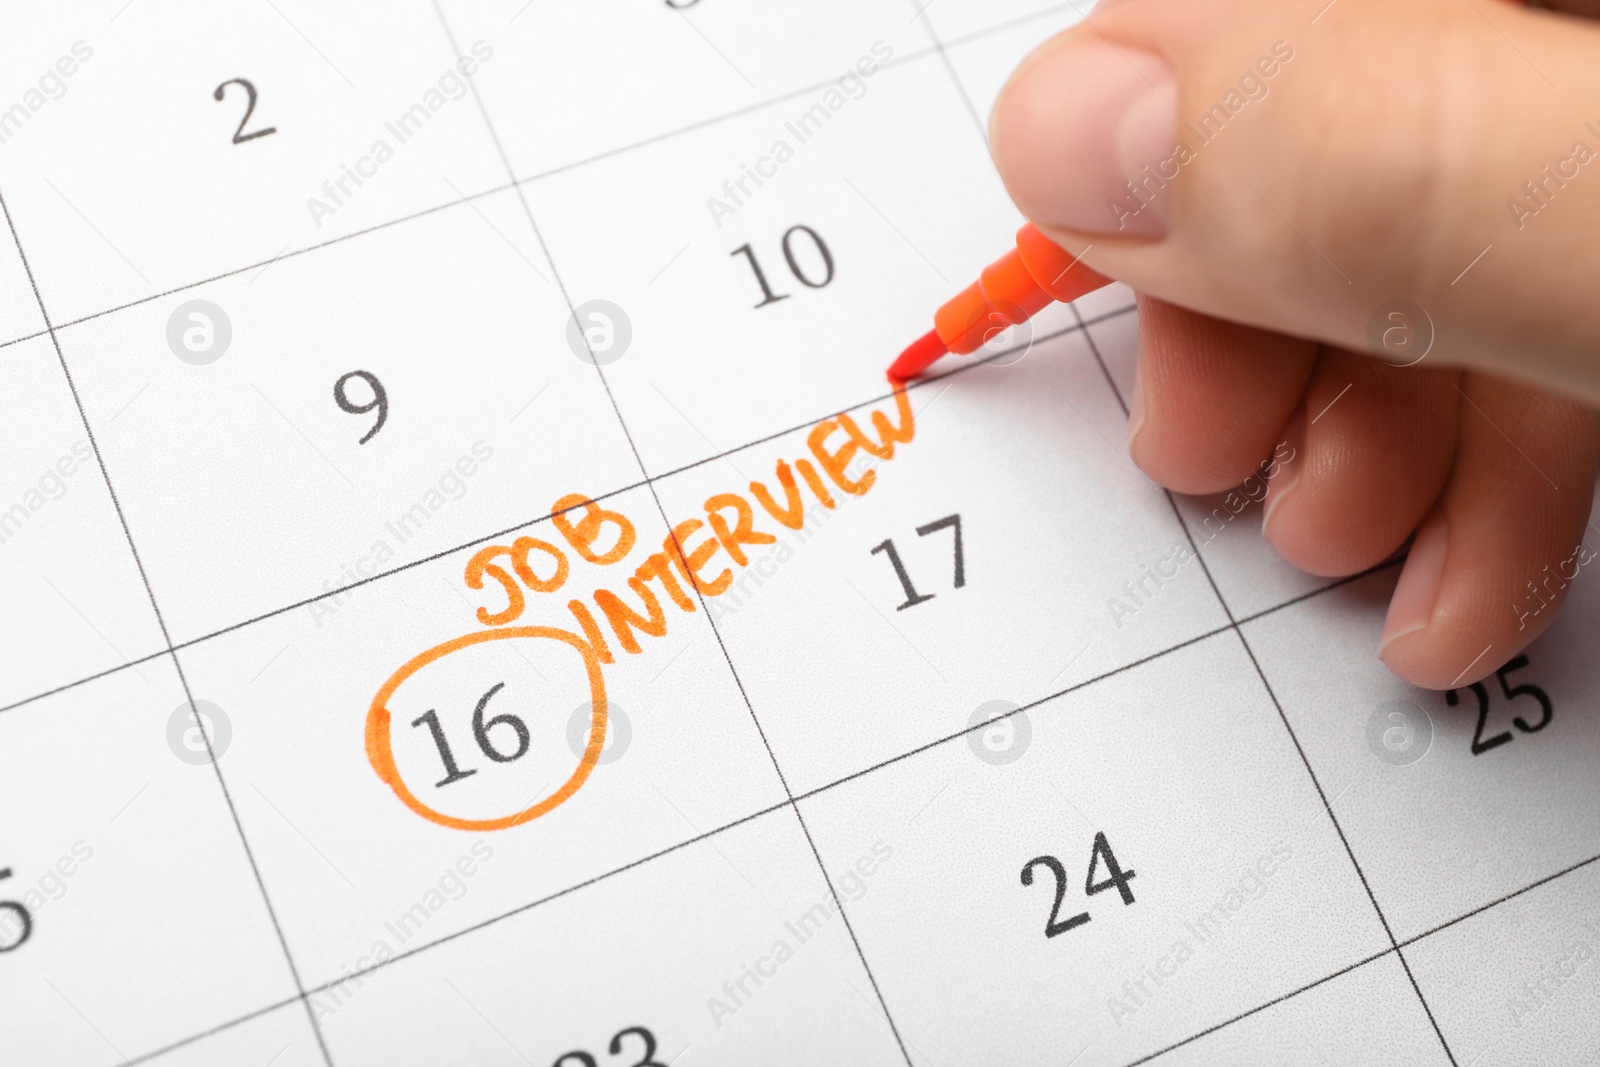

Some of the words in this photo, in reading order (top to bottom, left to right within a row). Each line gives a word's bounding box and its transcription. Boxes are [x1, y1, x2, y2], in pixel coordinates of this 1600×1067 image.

[212, 78, 277, 145] 2
[730, 225, 836, 310] 10
[333, 370, 389, 446] 9
[465, 493, 636, 626] JOB
[568, 381, 915, 664] INTERVIEW
[870, 514, 966, 612] 17
[411, 682, 531, 788] 16
[1446, 654, 1554, 756] 25
[1020, 831, 1136, 939] 24
